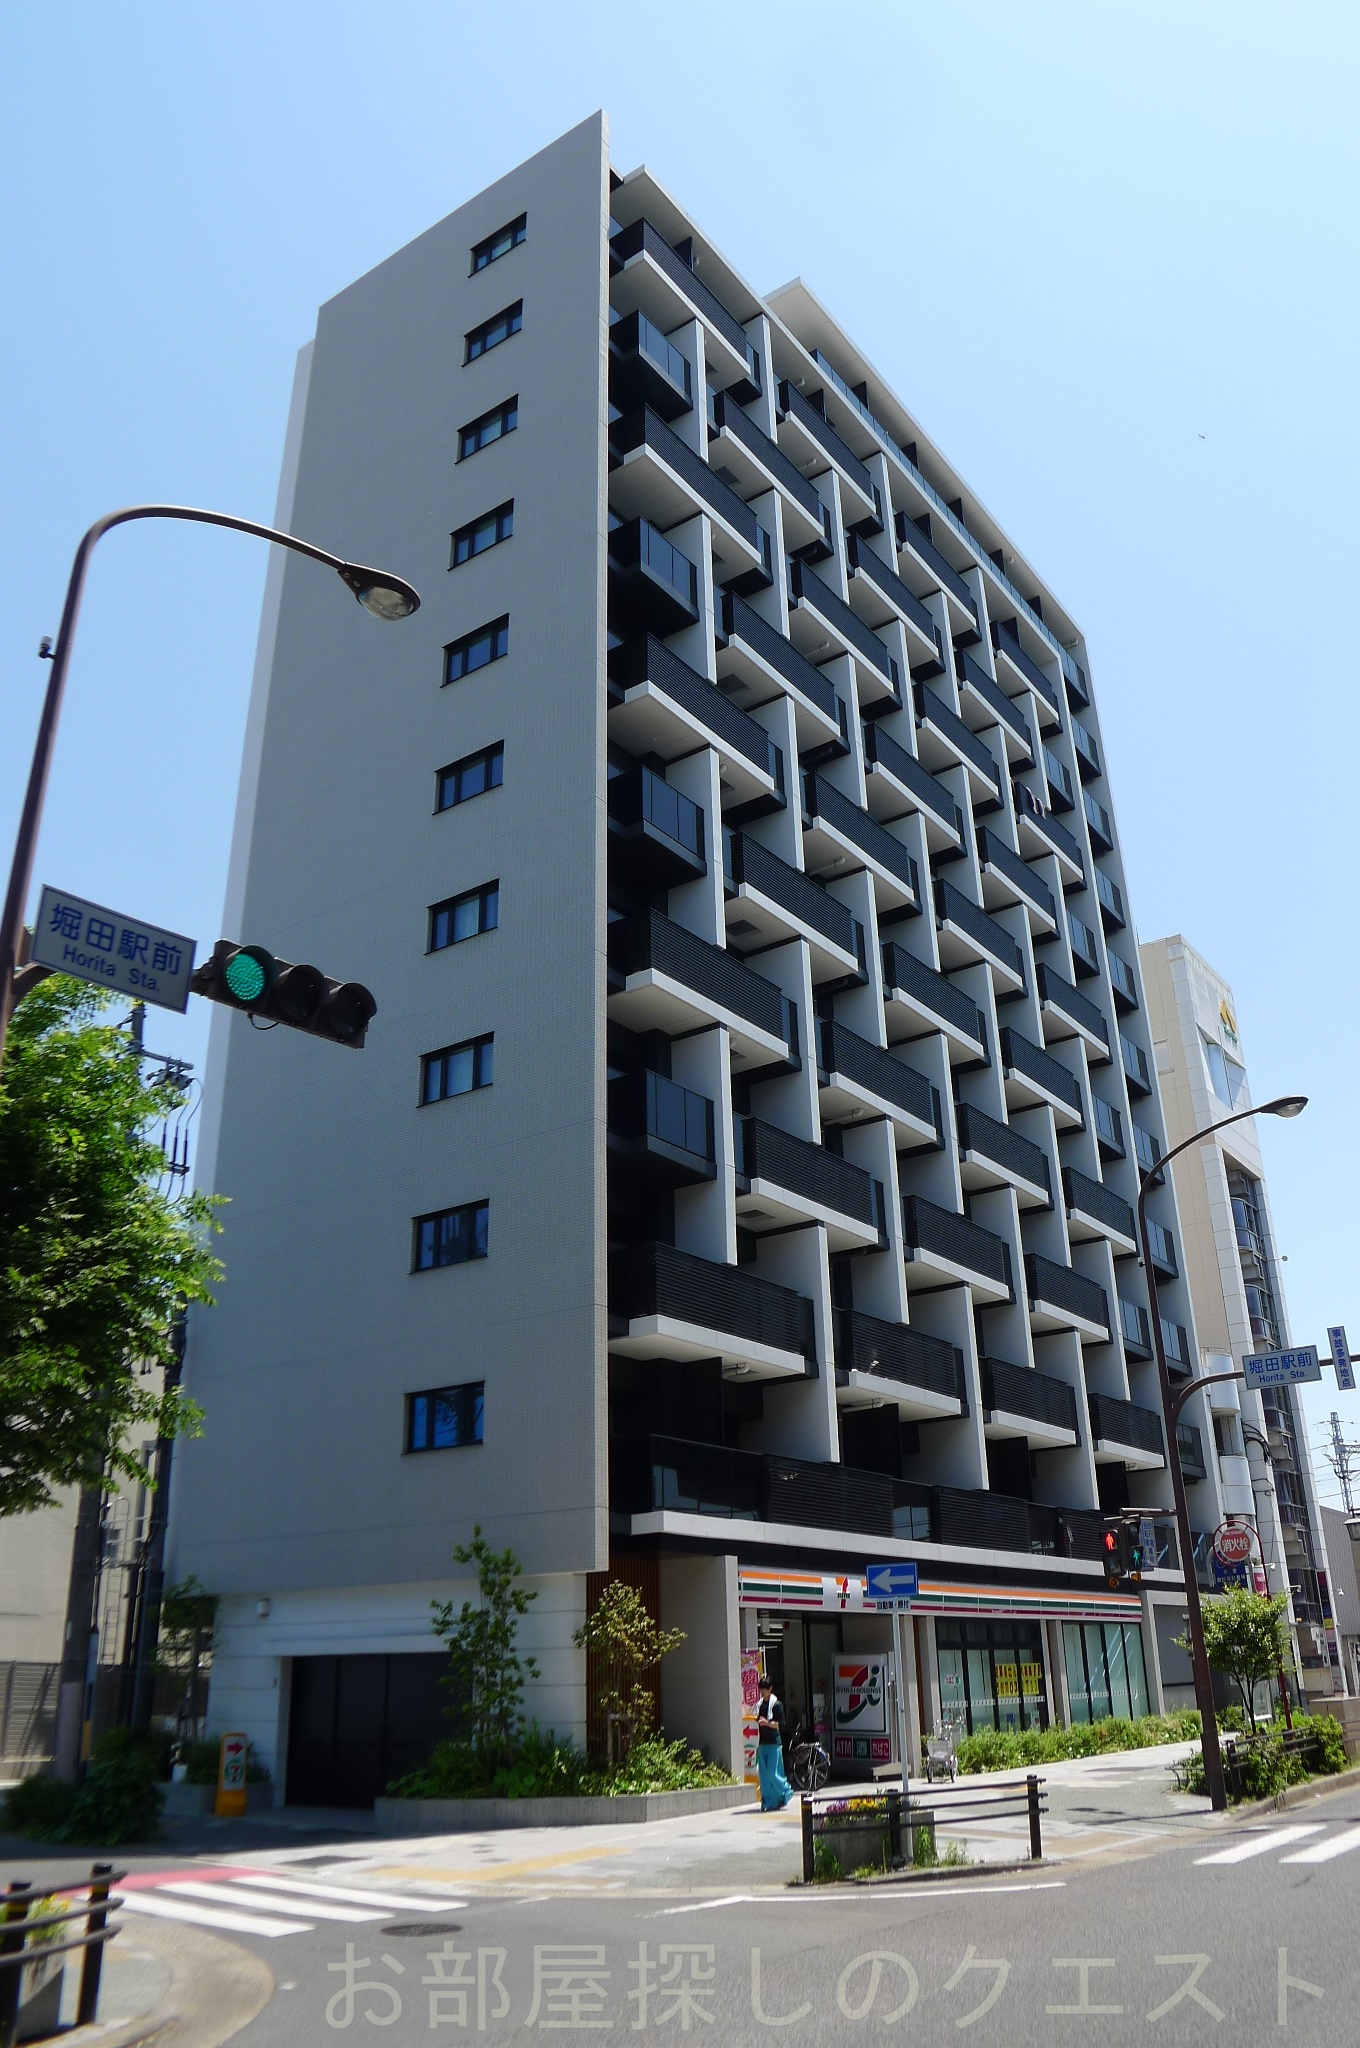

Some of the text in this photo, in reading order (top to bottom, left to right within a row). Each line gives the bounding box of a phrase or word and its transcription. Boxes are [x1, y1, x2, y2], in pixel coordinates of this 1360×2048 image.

[49, 903, 182, 976] 堀田駅前
[62, 943, 161, 993] Horita Sta.
[1248, 1351, 1312, 1375] 堀田駅前
[1331, 1328, 1352, 1388] 事故多発地点
[1258, 1373, 1285, 1383] Horita
[1221, 1537, 1250, 1553] 消火栓
[835, 1739, 852, 1756] ATM
[872, 1741, 889, 1757] たばこ
